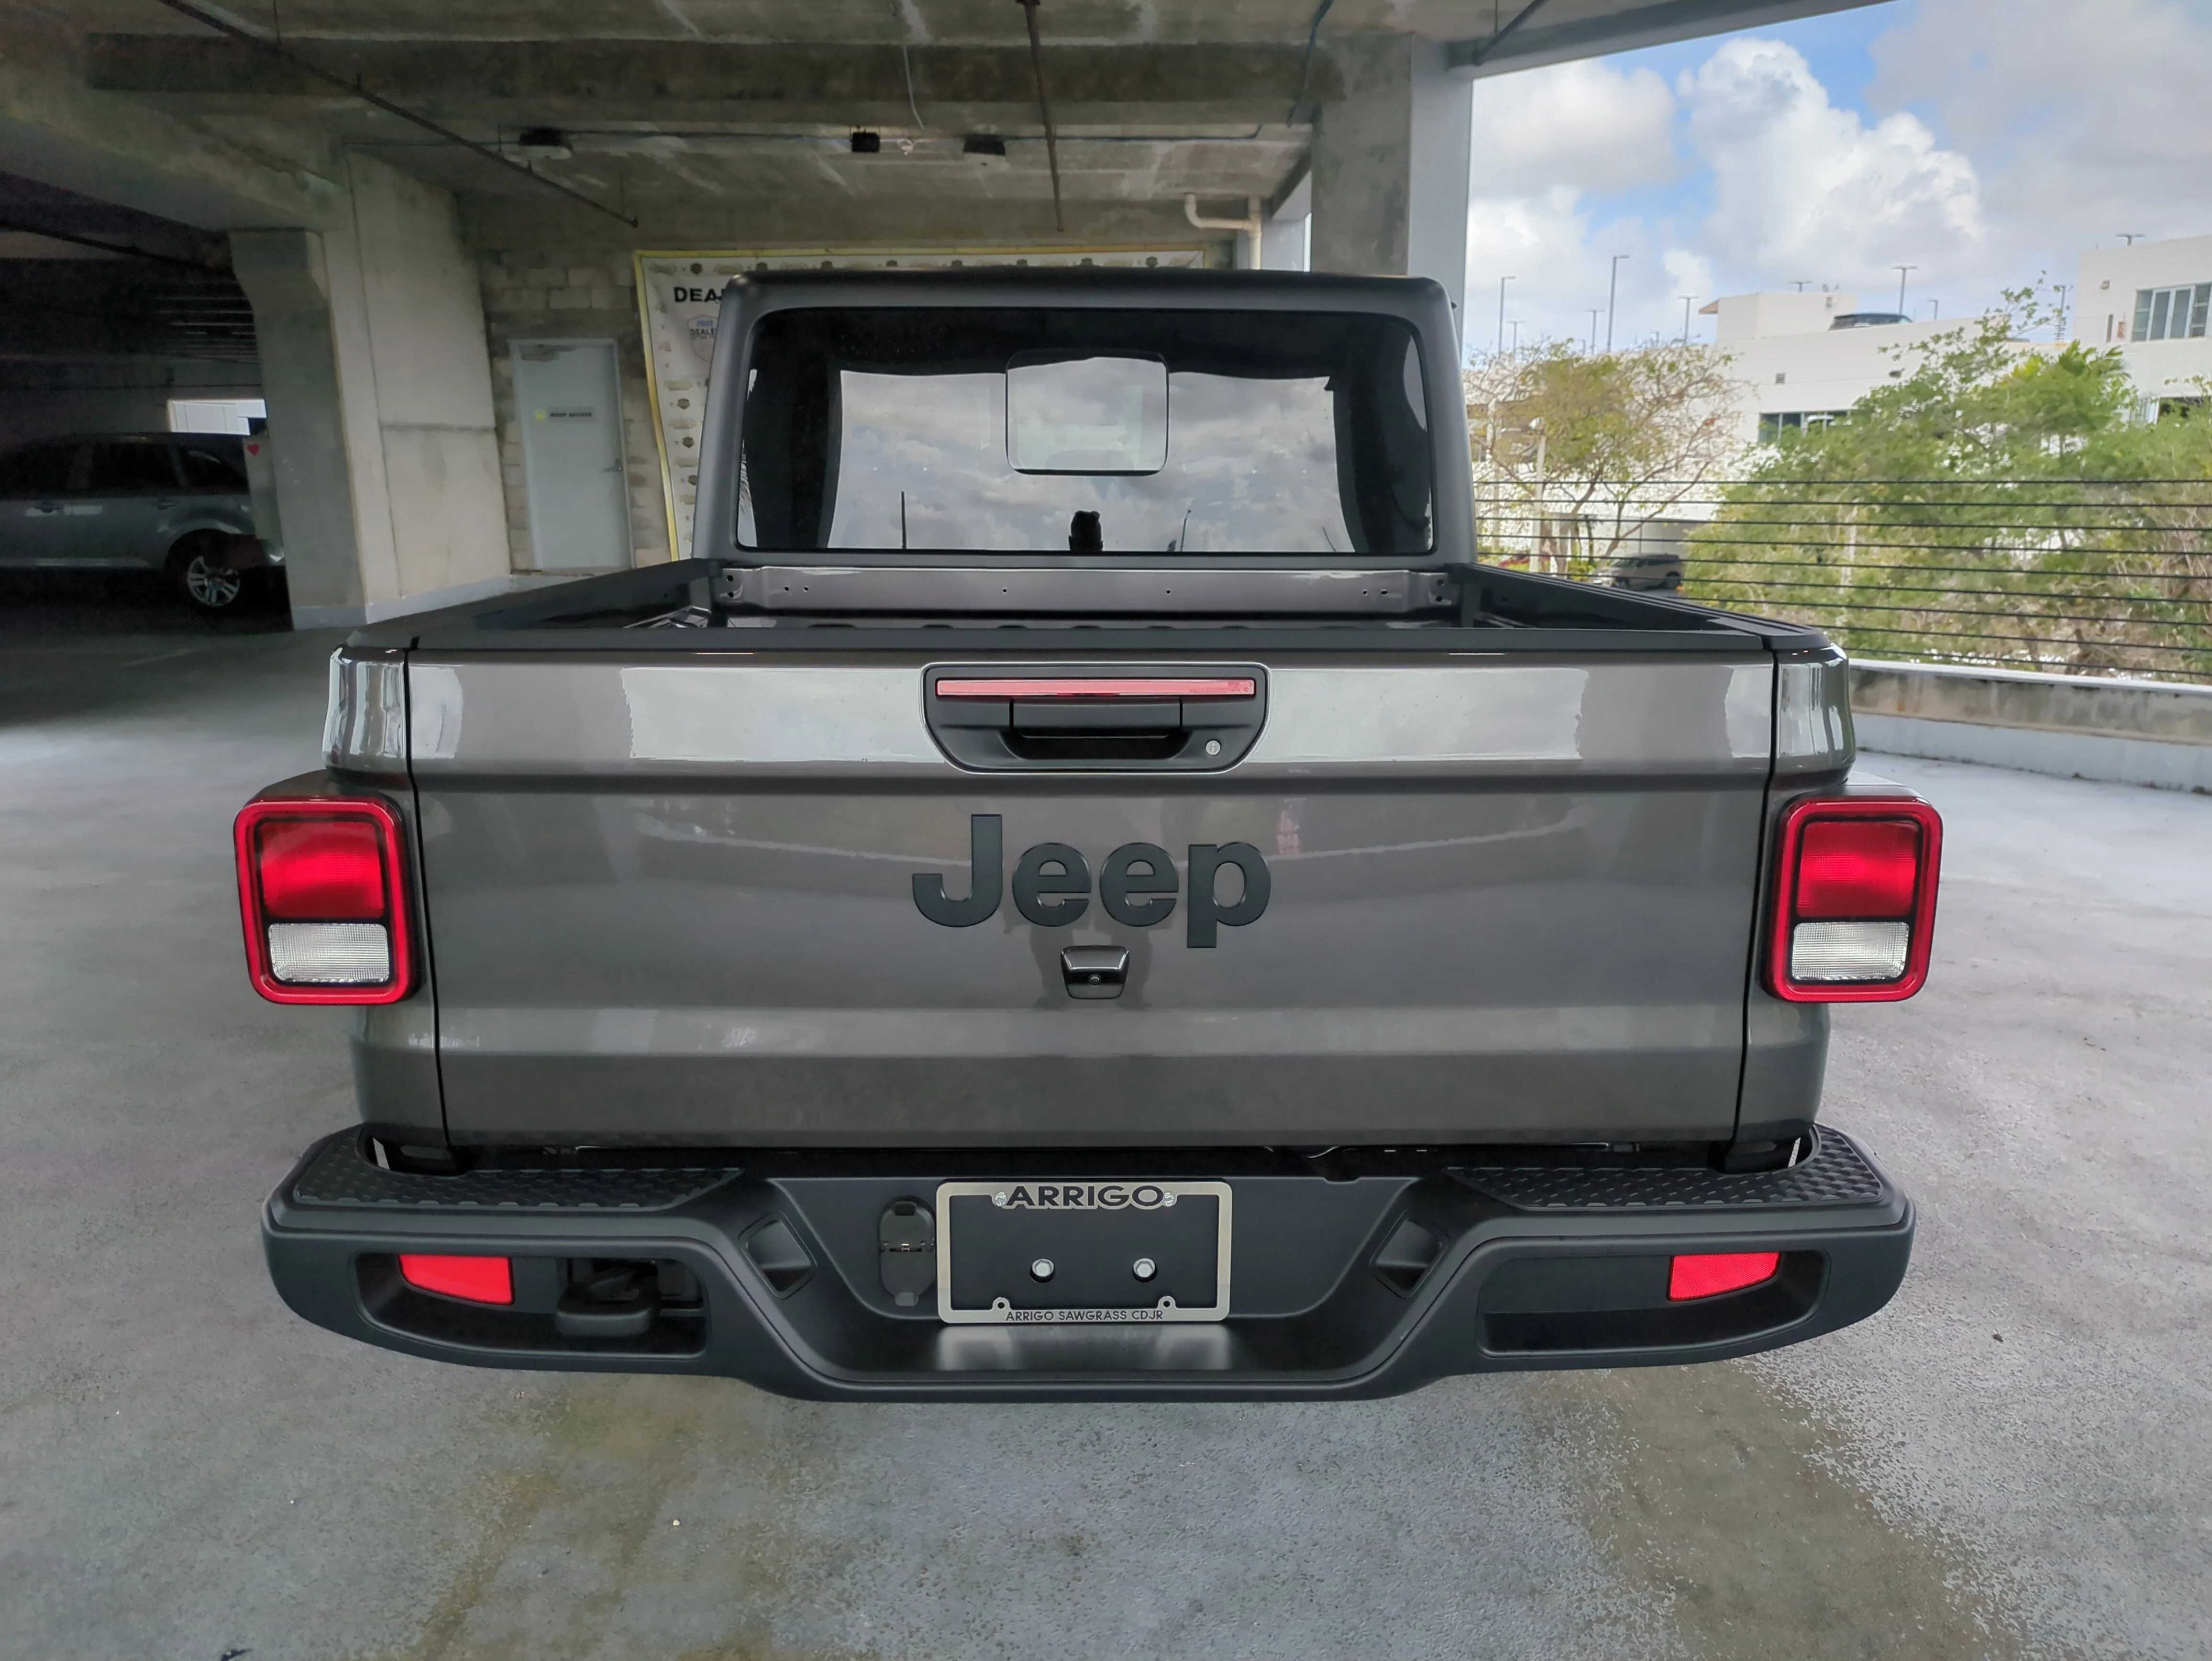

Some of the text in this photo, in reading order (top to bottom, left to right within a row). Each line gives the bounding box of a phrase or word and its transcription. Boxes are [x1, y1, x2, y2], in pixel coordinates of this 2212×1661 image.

[674, 287, 724, 302] DEA
[912, 814, 1271, 948] Jeep
[1006, 1185, 1163, 1207] ARRIGO
[1006, 1310, 1163, 1321] ARRIGO SAWGRASS CDJR
